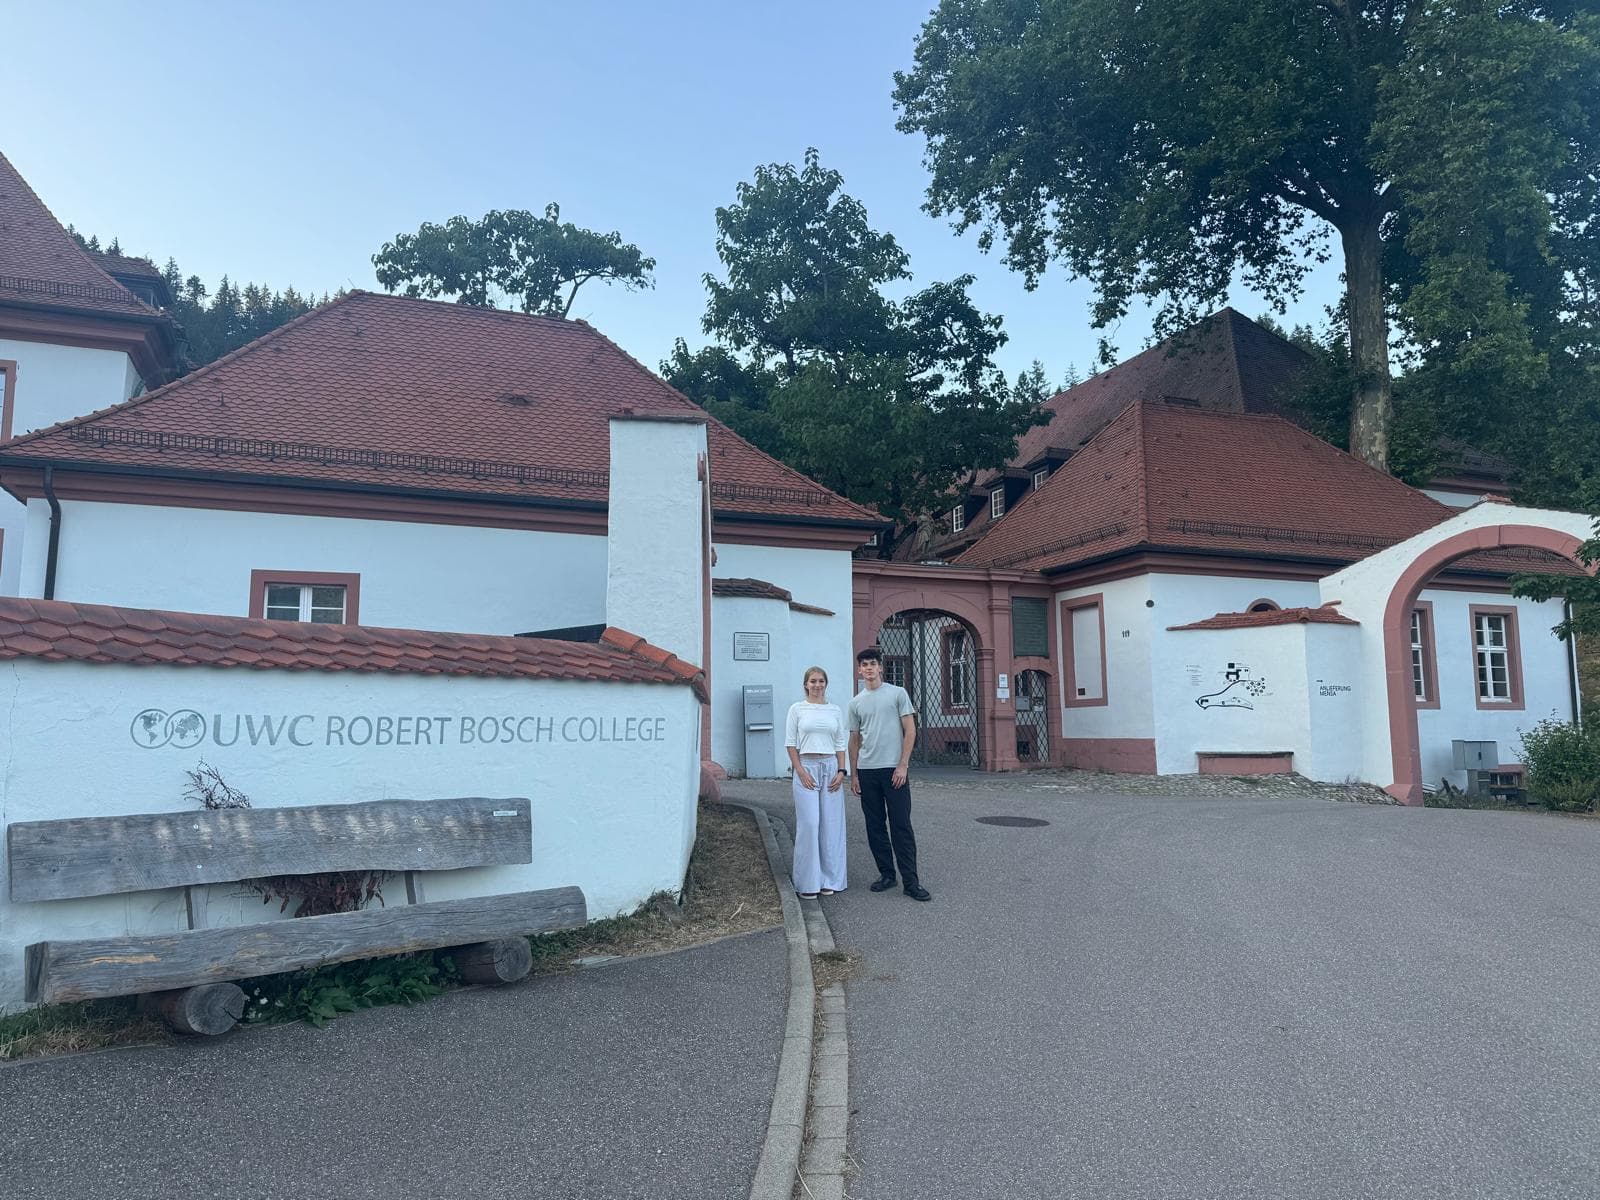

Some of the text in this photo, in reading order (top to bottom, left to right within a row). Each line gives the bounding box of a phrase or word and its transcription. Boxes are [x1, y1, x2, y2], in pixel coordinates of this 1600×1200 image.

[212, 713, 666, 747] UWC ROBERT BOSCH COLLEGE
